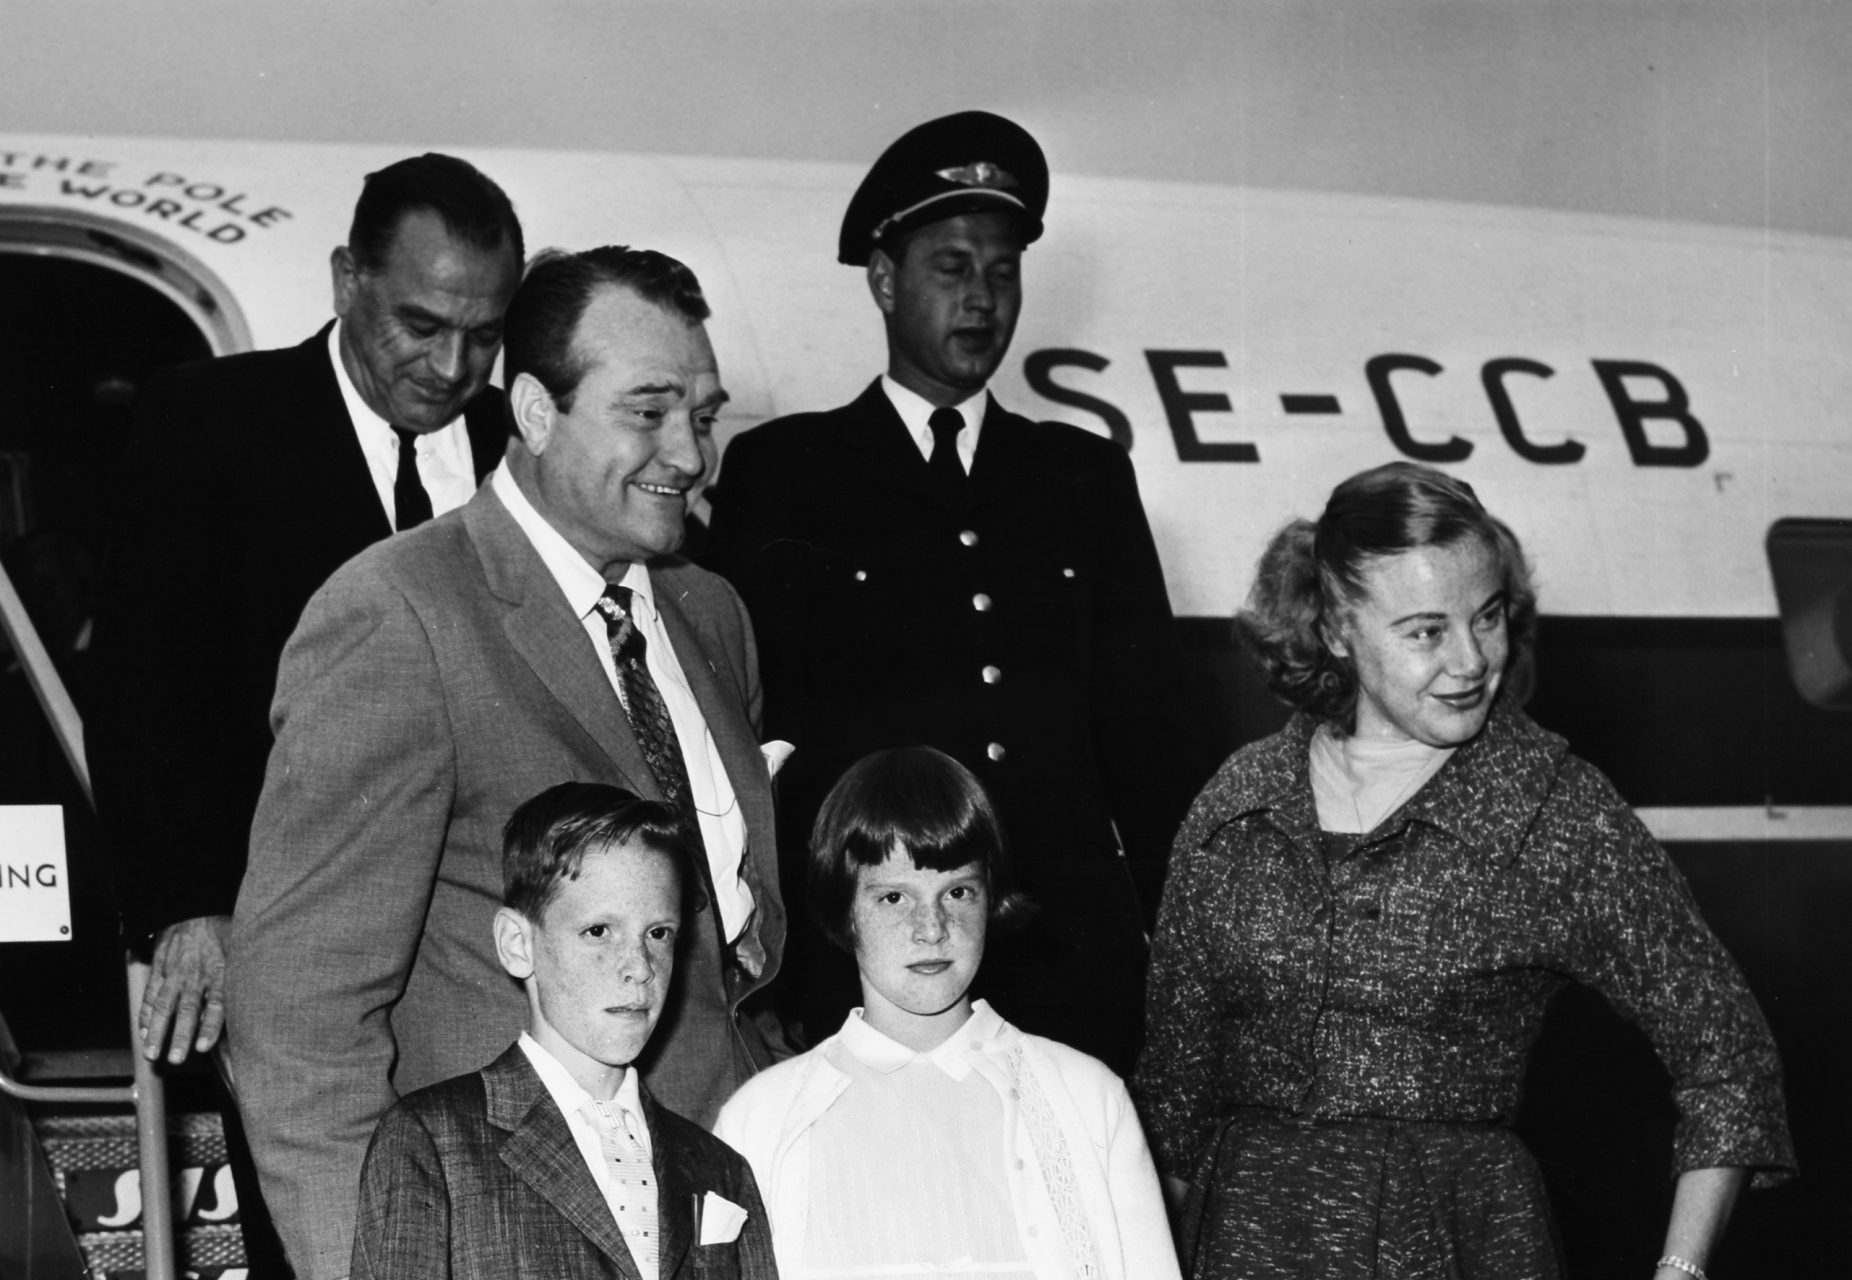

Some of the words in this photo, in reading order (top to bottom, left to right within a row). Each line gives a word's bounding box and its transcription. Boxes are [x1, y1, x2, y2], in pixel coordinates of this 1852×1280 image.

[0, 151, 118, 178] THE
[144, 172, 294, 229] POLE
[60, 178, 247, 245] WORLD
[1023, 347, 1710, 468] SE-CCB
